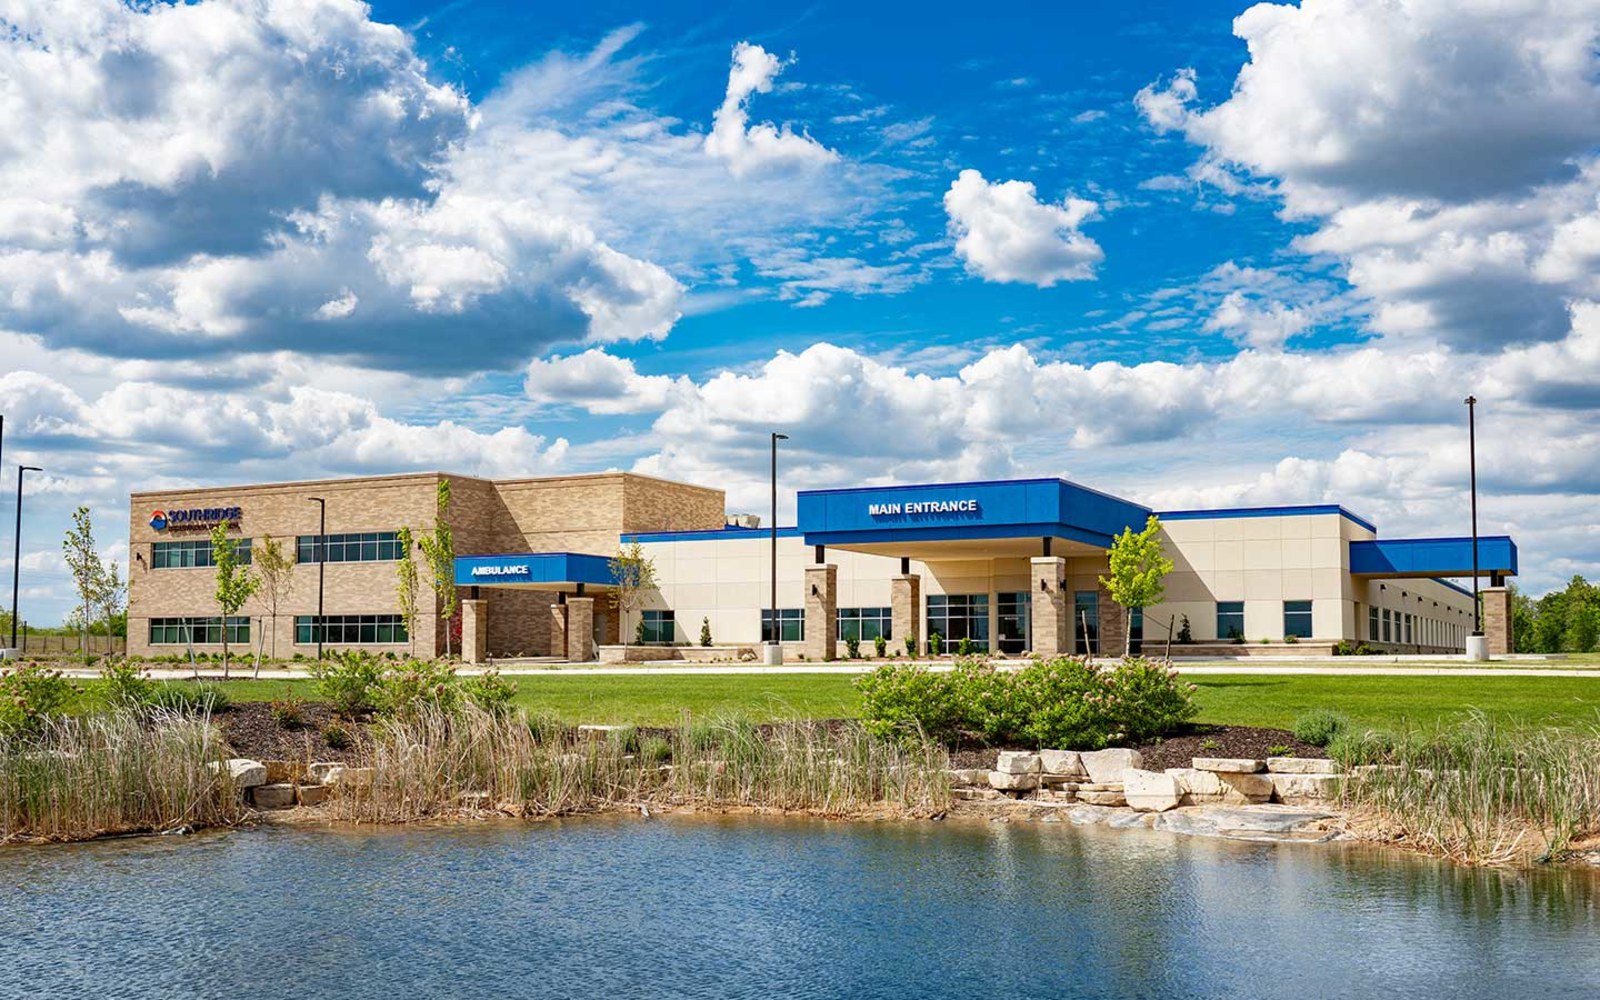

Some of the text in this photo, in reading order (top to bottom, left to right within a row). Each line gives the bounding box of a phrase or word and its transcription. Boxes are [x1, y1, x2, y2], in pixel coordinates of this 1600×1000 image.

[168, 507, 242, 522] SOUTHRIDGE
[868, 500, 977, 515] MAIN ENTRANCE
[471, 565, 529, 576] AMBULANCE
